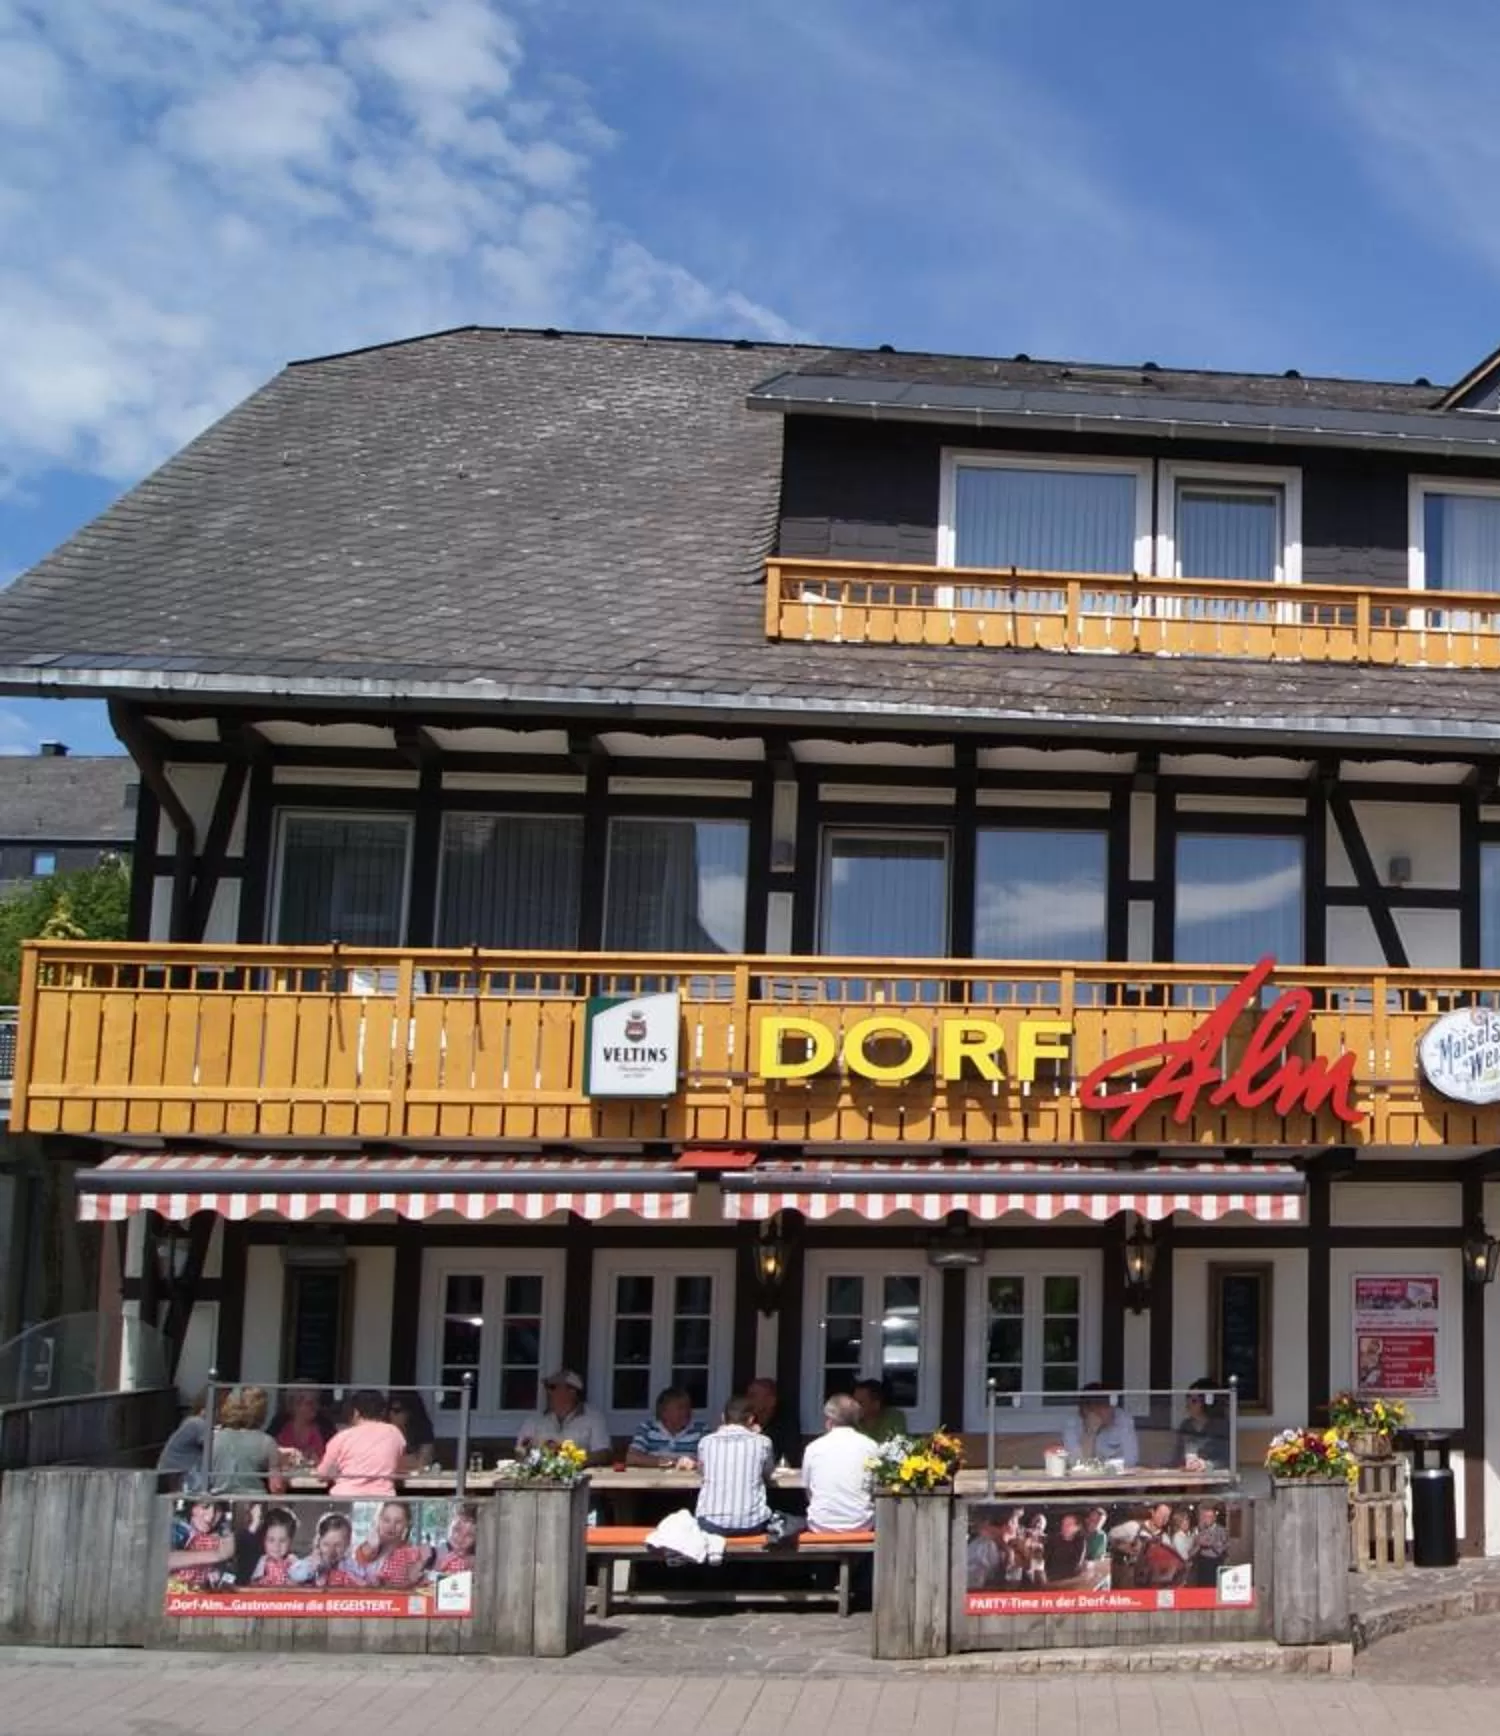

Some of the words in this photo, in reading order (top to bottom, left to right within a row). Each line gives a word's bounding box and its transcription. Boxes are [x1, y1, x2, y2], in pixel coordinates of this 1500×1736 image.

[760, 1016, 1074, 1081] DORF
[1079, 951, 1366, 1140] Alm
[603, 1047, 668, 1063] VELTINS
[1041, 1596, 1055, 1608] in
